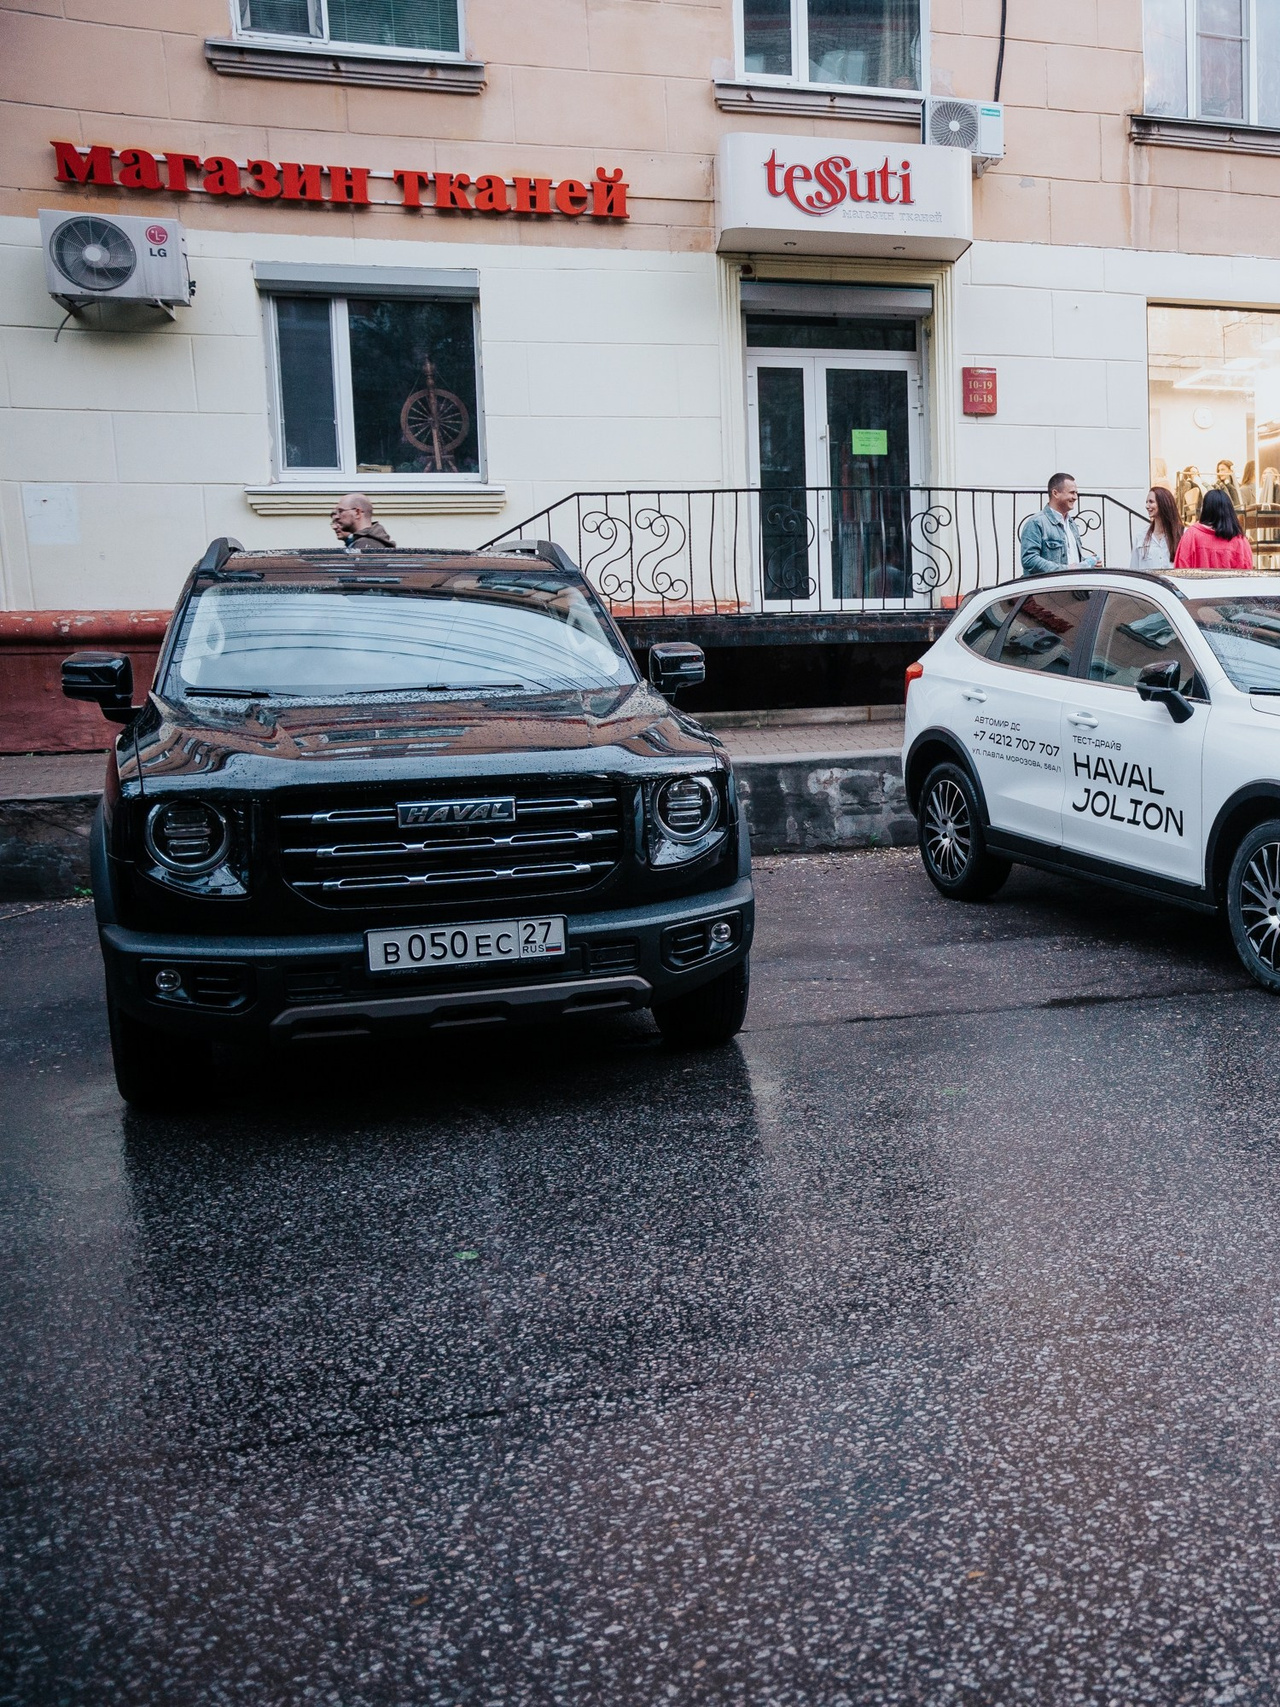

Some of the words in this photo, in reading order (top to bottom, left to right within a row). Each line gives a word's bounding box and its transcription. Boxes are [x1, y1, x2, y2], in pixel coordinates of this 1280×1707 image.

[50, 141, 372, 205] магазин
[393, 166, 630, 219] тканей
[149, 247, 168, 258] LG
[968, 380, 994, 390] 10-19
[968, 394, 994, 403] 10-18
[974, 715, 1009, 728] АВТОМИР
[1010, 722, 1021, 731] ДС
[973, 731, 986, 741] +7
[988, 732, 1012, 747] 4212
[1015, 738, 1036, 752] 707
[1039, 742, 1060, 757] 707
[1072, 735, 1122, 751] ТЕСТ-ДРАЙВ
[982, 750, 1004, 760] ПАВЛА
[1073, 752, 1165, 796] HAVAL
[406, 803, 509, 823] HAVAL
[1072, 788, 1184, 837] JOLION
[522, 921, 552, 945] 27
[522, 944, 545, 954] RUS
